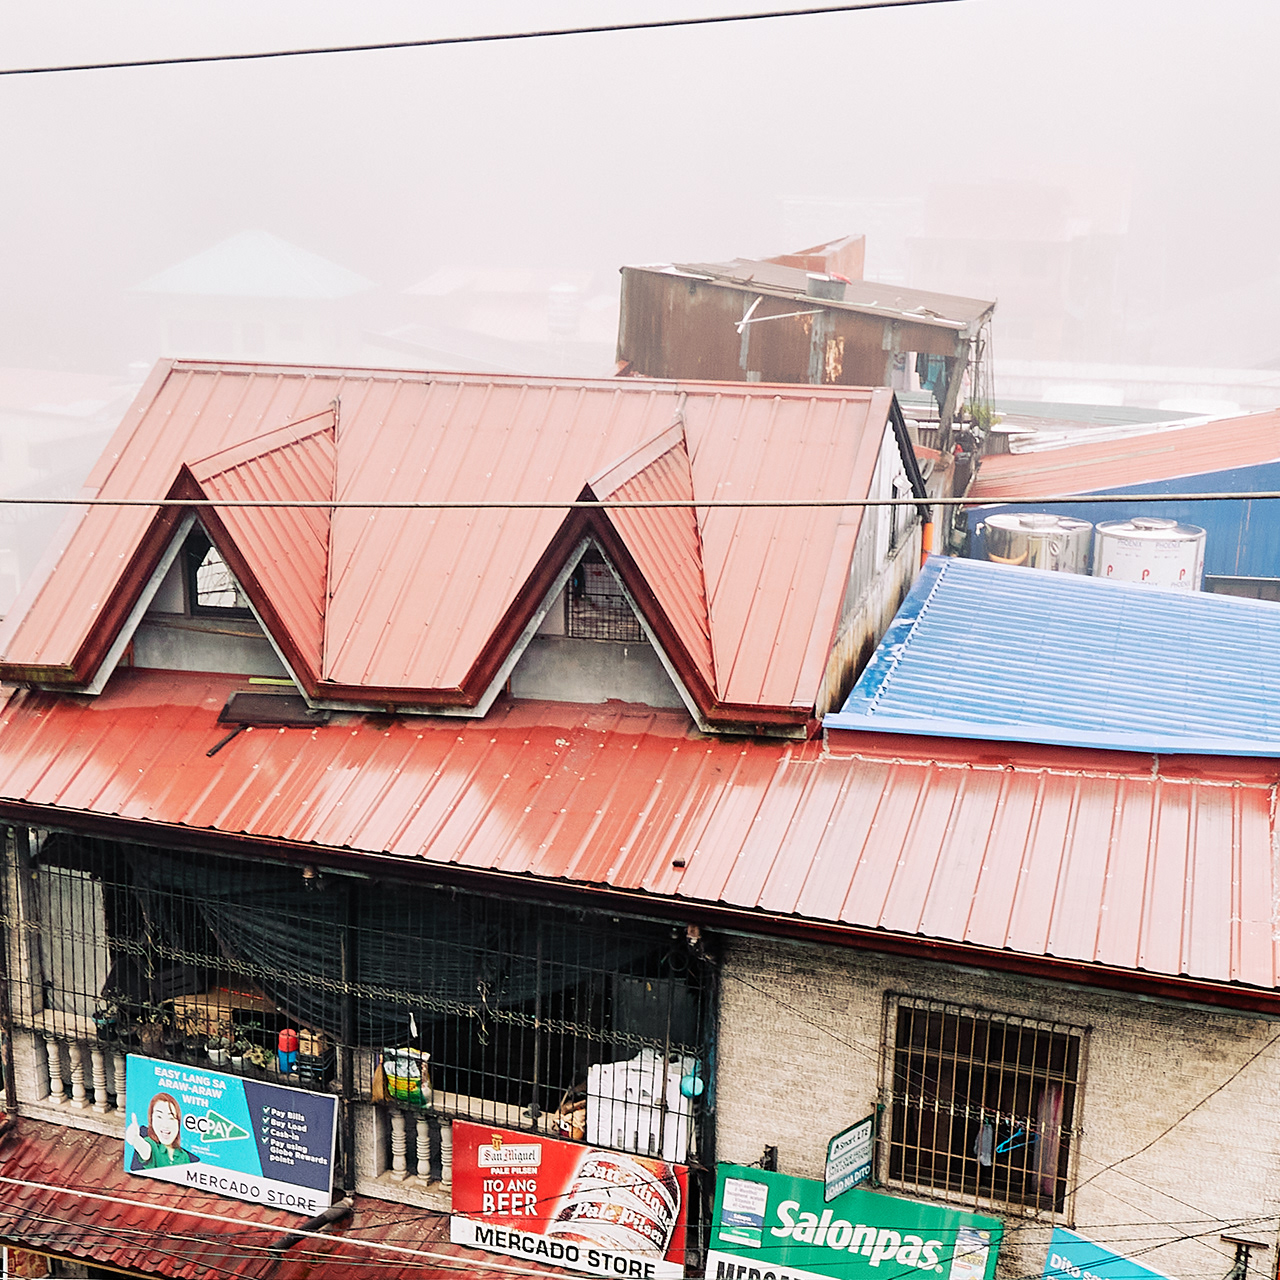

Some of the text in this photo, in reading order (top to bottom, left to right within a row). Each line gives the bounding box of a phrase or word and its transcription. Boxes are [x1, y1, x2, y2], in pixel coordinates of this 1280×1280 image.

[154, 1066, 227, 1090] EASY LANG SA
[158, 1078, 223, 1099] ARAW-ARAW
[182, 1094, 209, 1108] WITH
[271, 1107, 306, 1122] Pay Bills
[270, 1118, 308, 1133] Buy Load
[270, 1138, 308, 1154] Pay using
[269, 1146, 328, 1165] Globe Rewards
[269, 1155, 295, 1166] points
[484, 1148, 536, 1164] San Miguel
[490, 1167, 538, 1175] PALE PILSEN
[186, 1170, 318, 1212] MERCADO STORE
[483, 1179, 537, 1191] ITO ANG
[483, 1193, 538, 1216] BEER
[770, 1199, 943, 1271] Salonpas
[475, 1226, 656, 1280] MERCADO STORE
[1049, 1253, 1081, 1279] Dito
